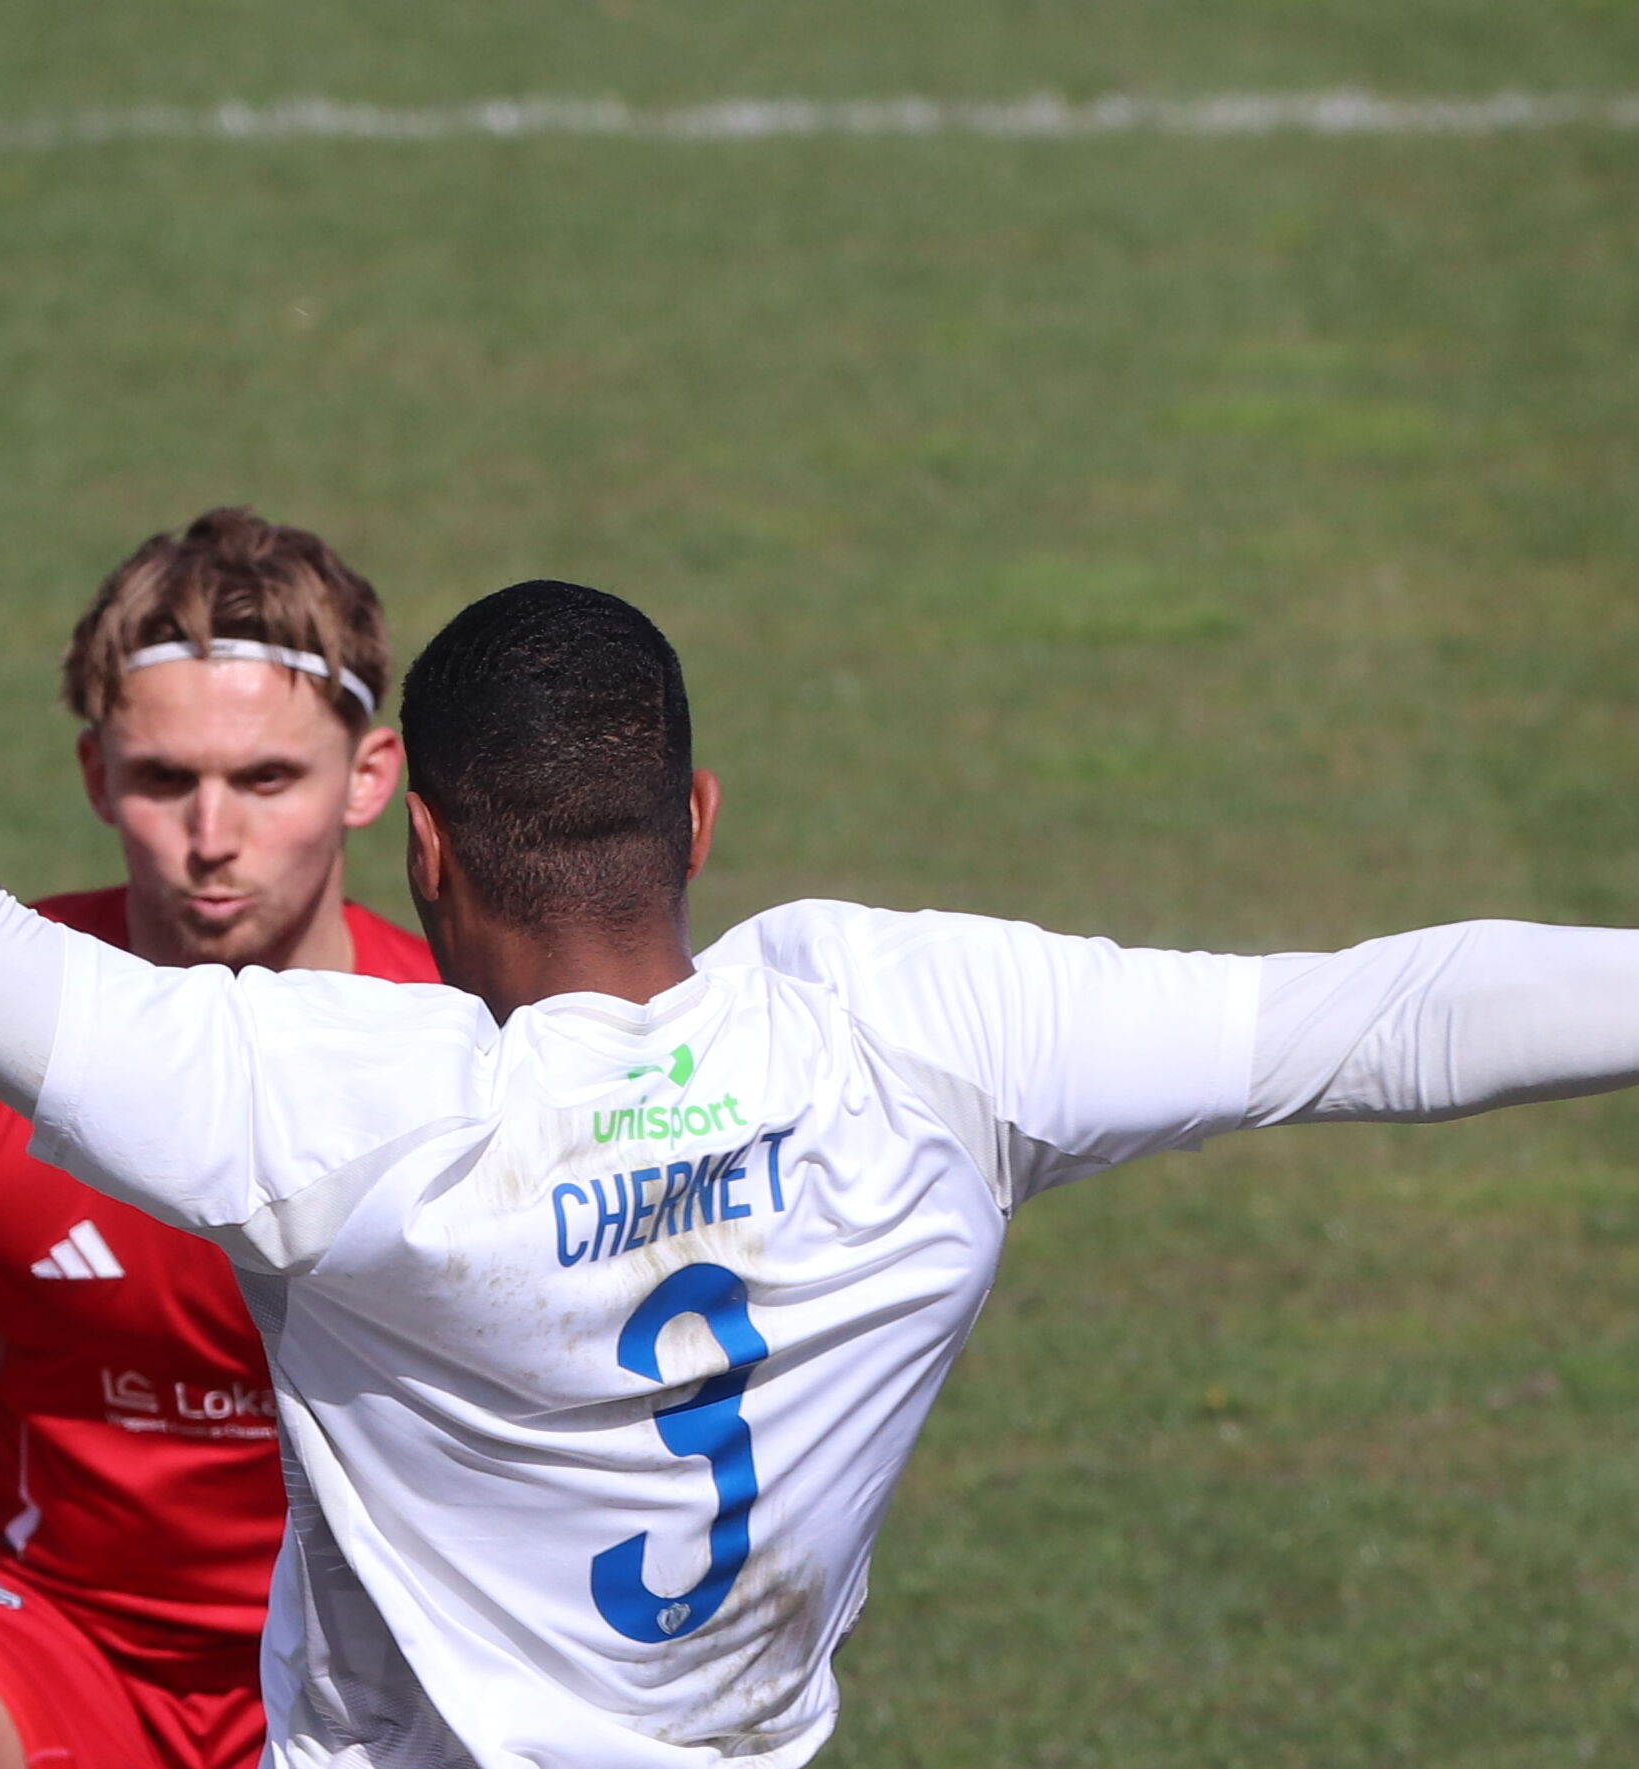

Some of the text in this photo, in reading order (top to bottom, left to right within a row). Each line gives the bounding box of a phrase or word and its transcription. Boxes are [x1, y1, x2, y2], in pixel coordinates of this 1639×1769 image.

[592, 1092, 749, 1151] unisport
[551, 1125, 798, 1269] CHERNET
[589, 1261, 770, 1644] 3
